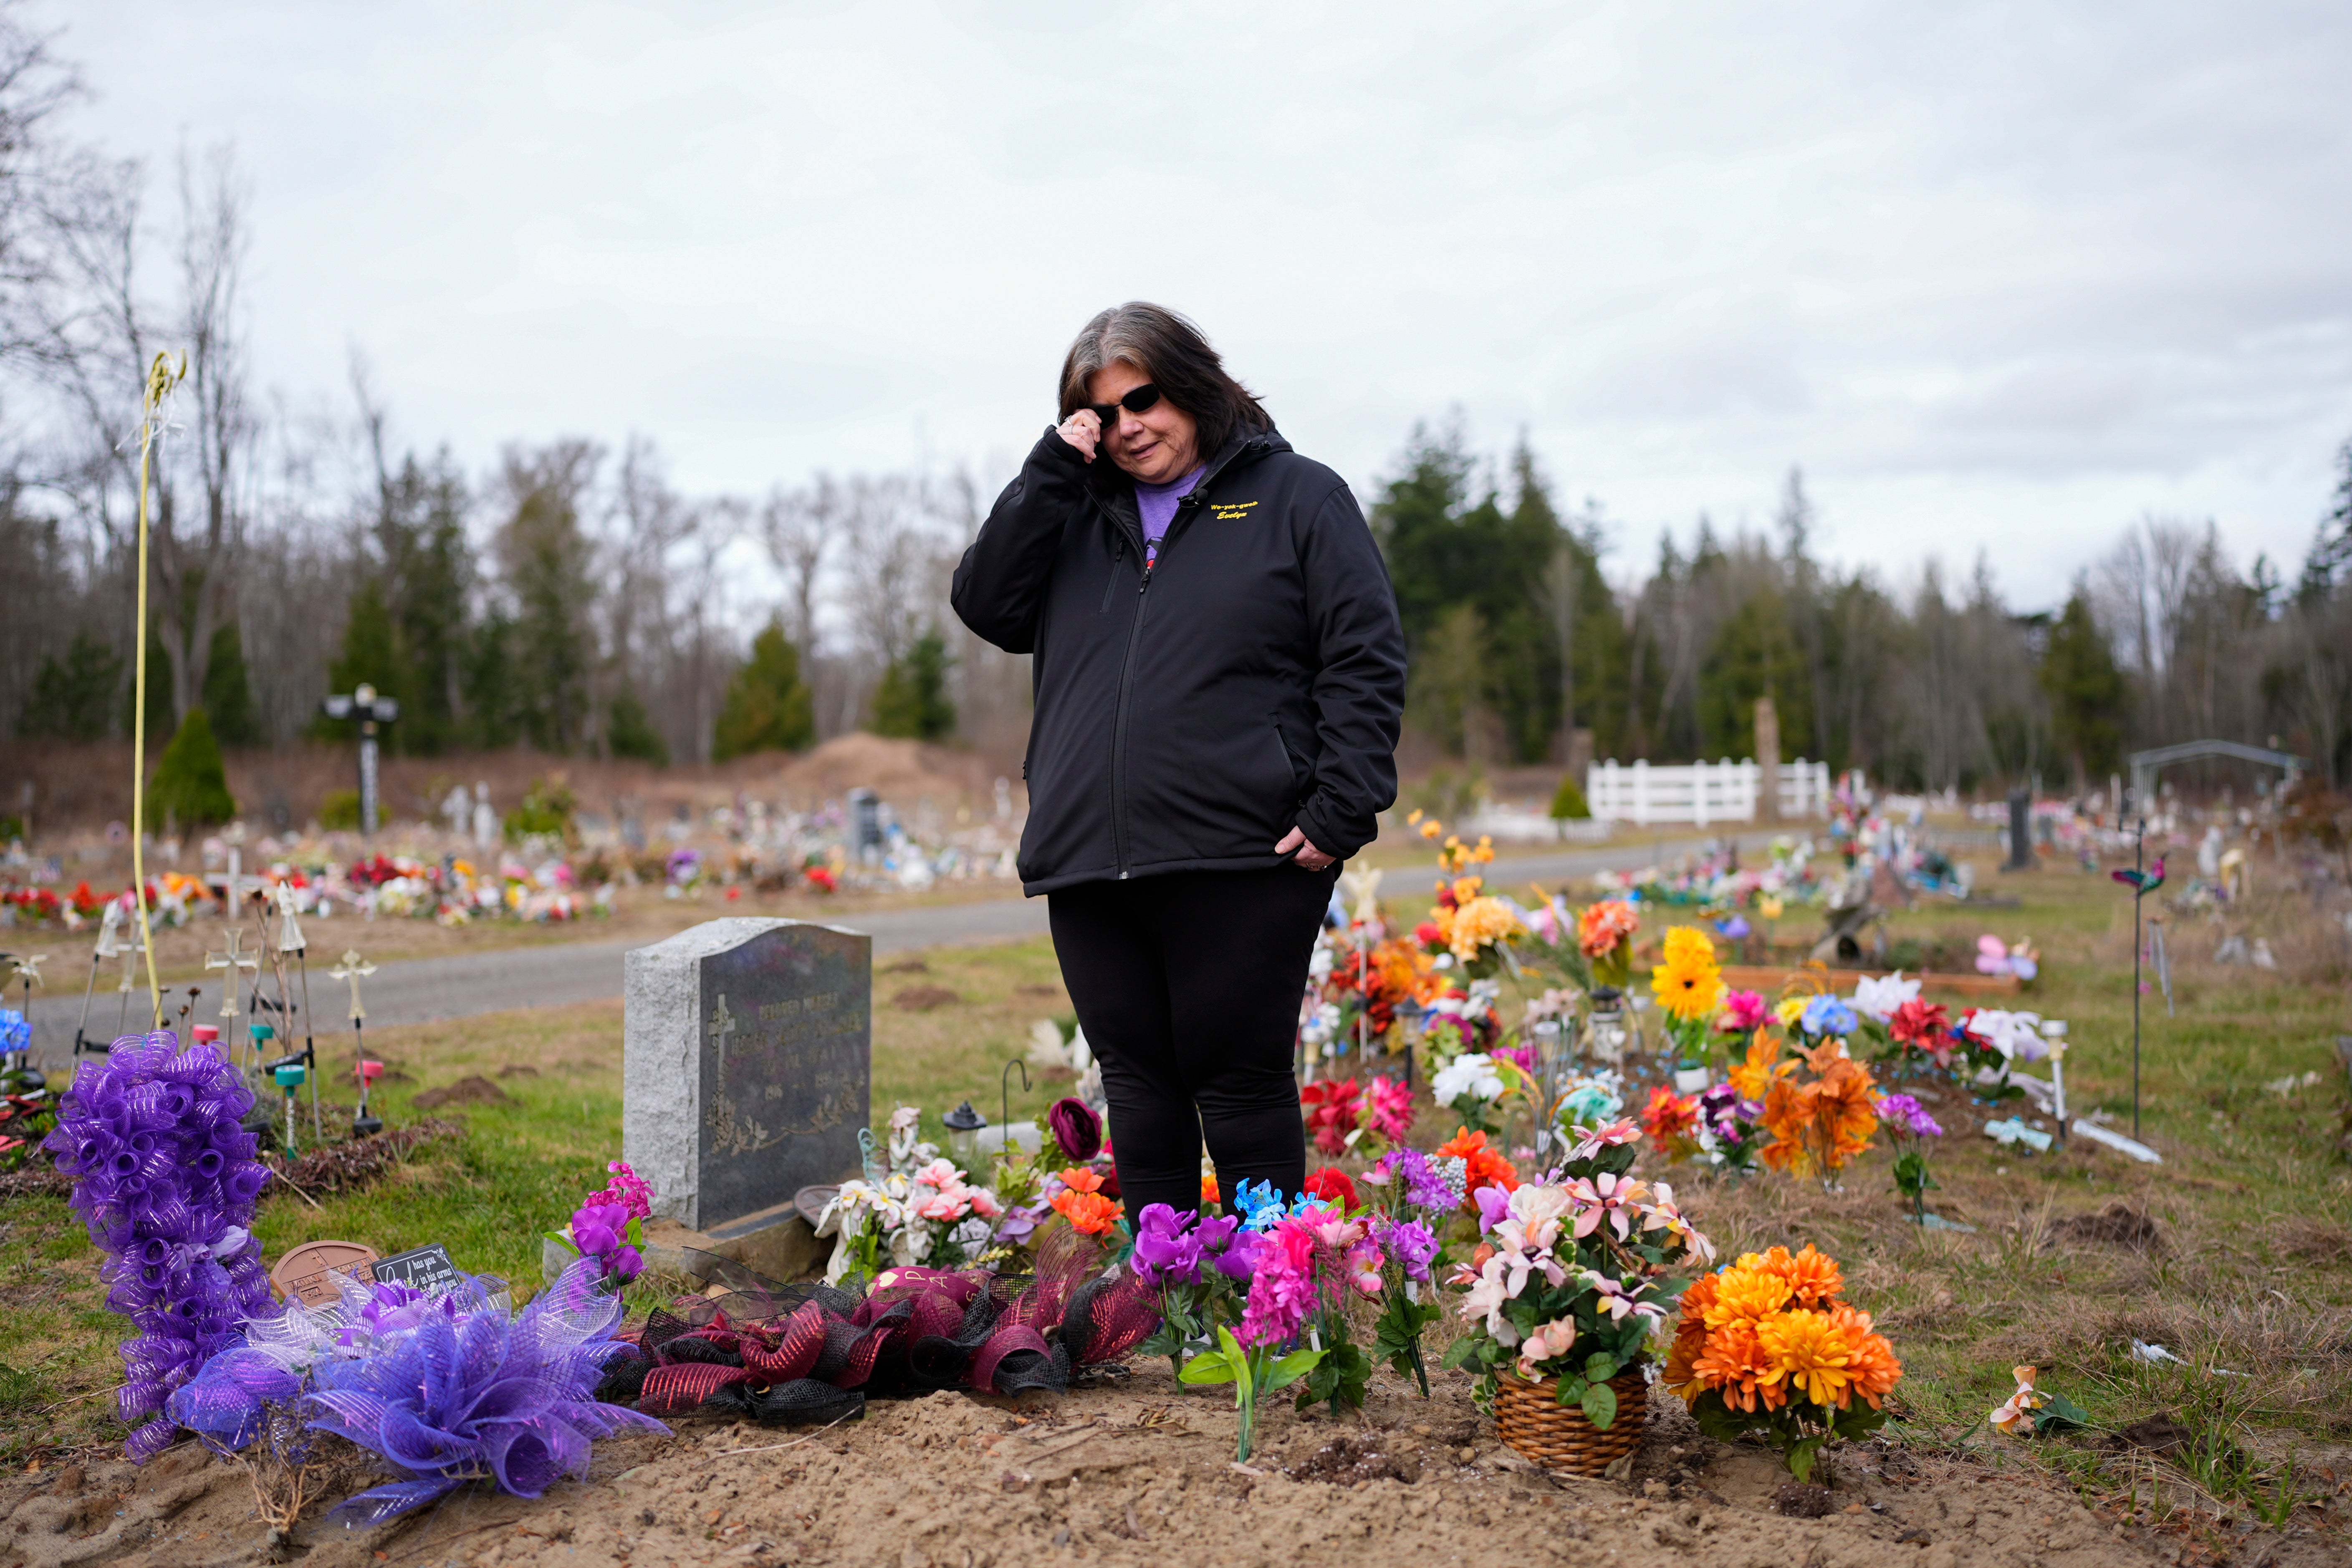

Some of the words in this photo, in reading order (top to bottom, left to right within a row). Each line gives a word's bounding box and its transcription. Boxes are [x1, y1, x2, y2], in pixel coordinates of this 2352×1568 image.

[412, 1260, 424, 1270] has
[424, 1256, 437, 1271] you
[419, 1275, 428, 1285] in
[426, 1272, 437, 1282] his
[437, 1268, 452, 1279] arms
[445, 1278, 458, 1293] you
